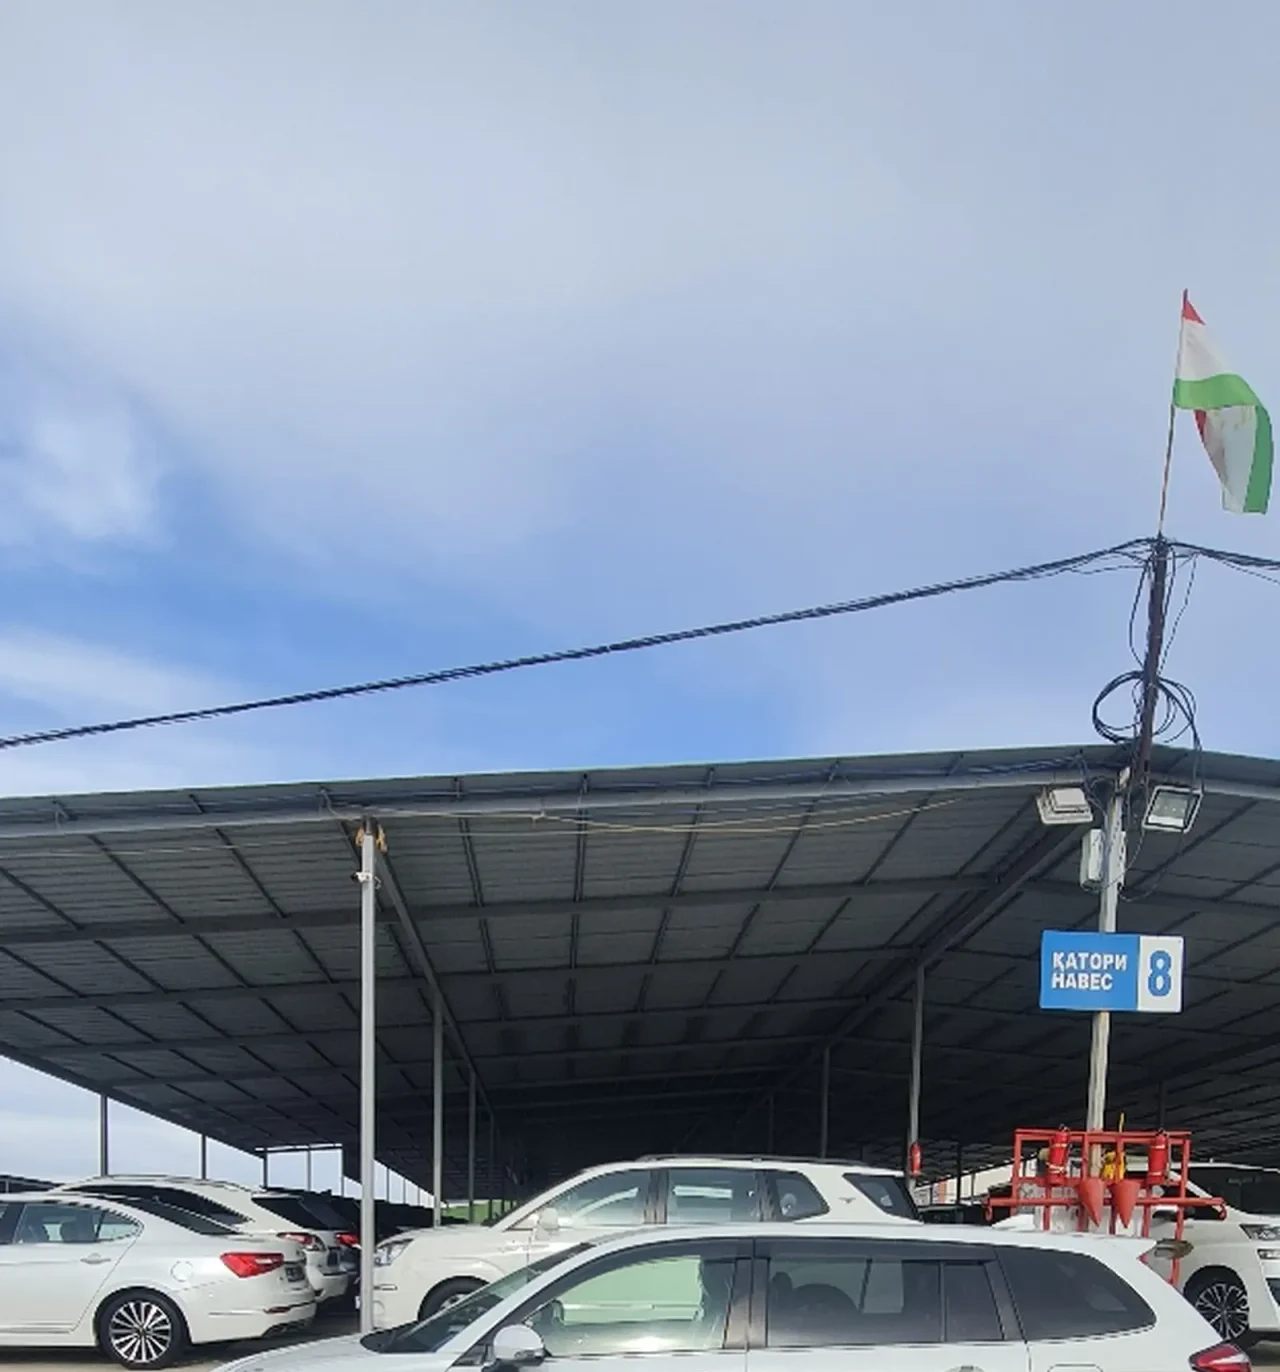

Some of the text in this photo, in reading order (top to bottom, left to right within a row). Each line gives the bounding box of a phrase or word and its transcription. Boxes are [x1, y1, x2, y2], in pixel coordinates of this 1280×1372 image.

[1052, 951, 1128, 972] ҚАТОРИ
[1051, 972, 1114, 991] НАВЕС
[1148, 950, 1172, 997] 8
